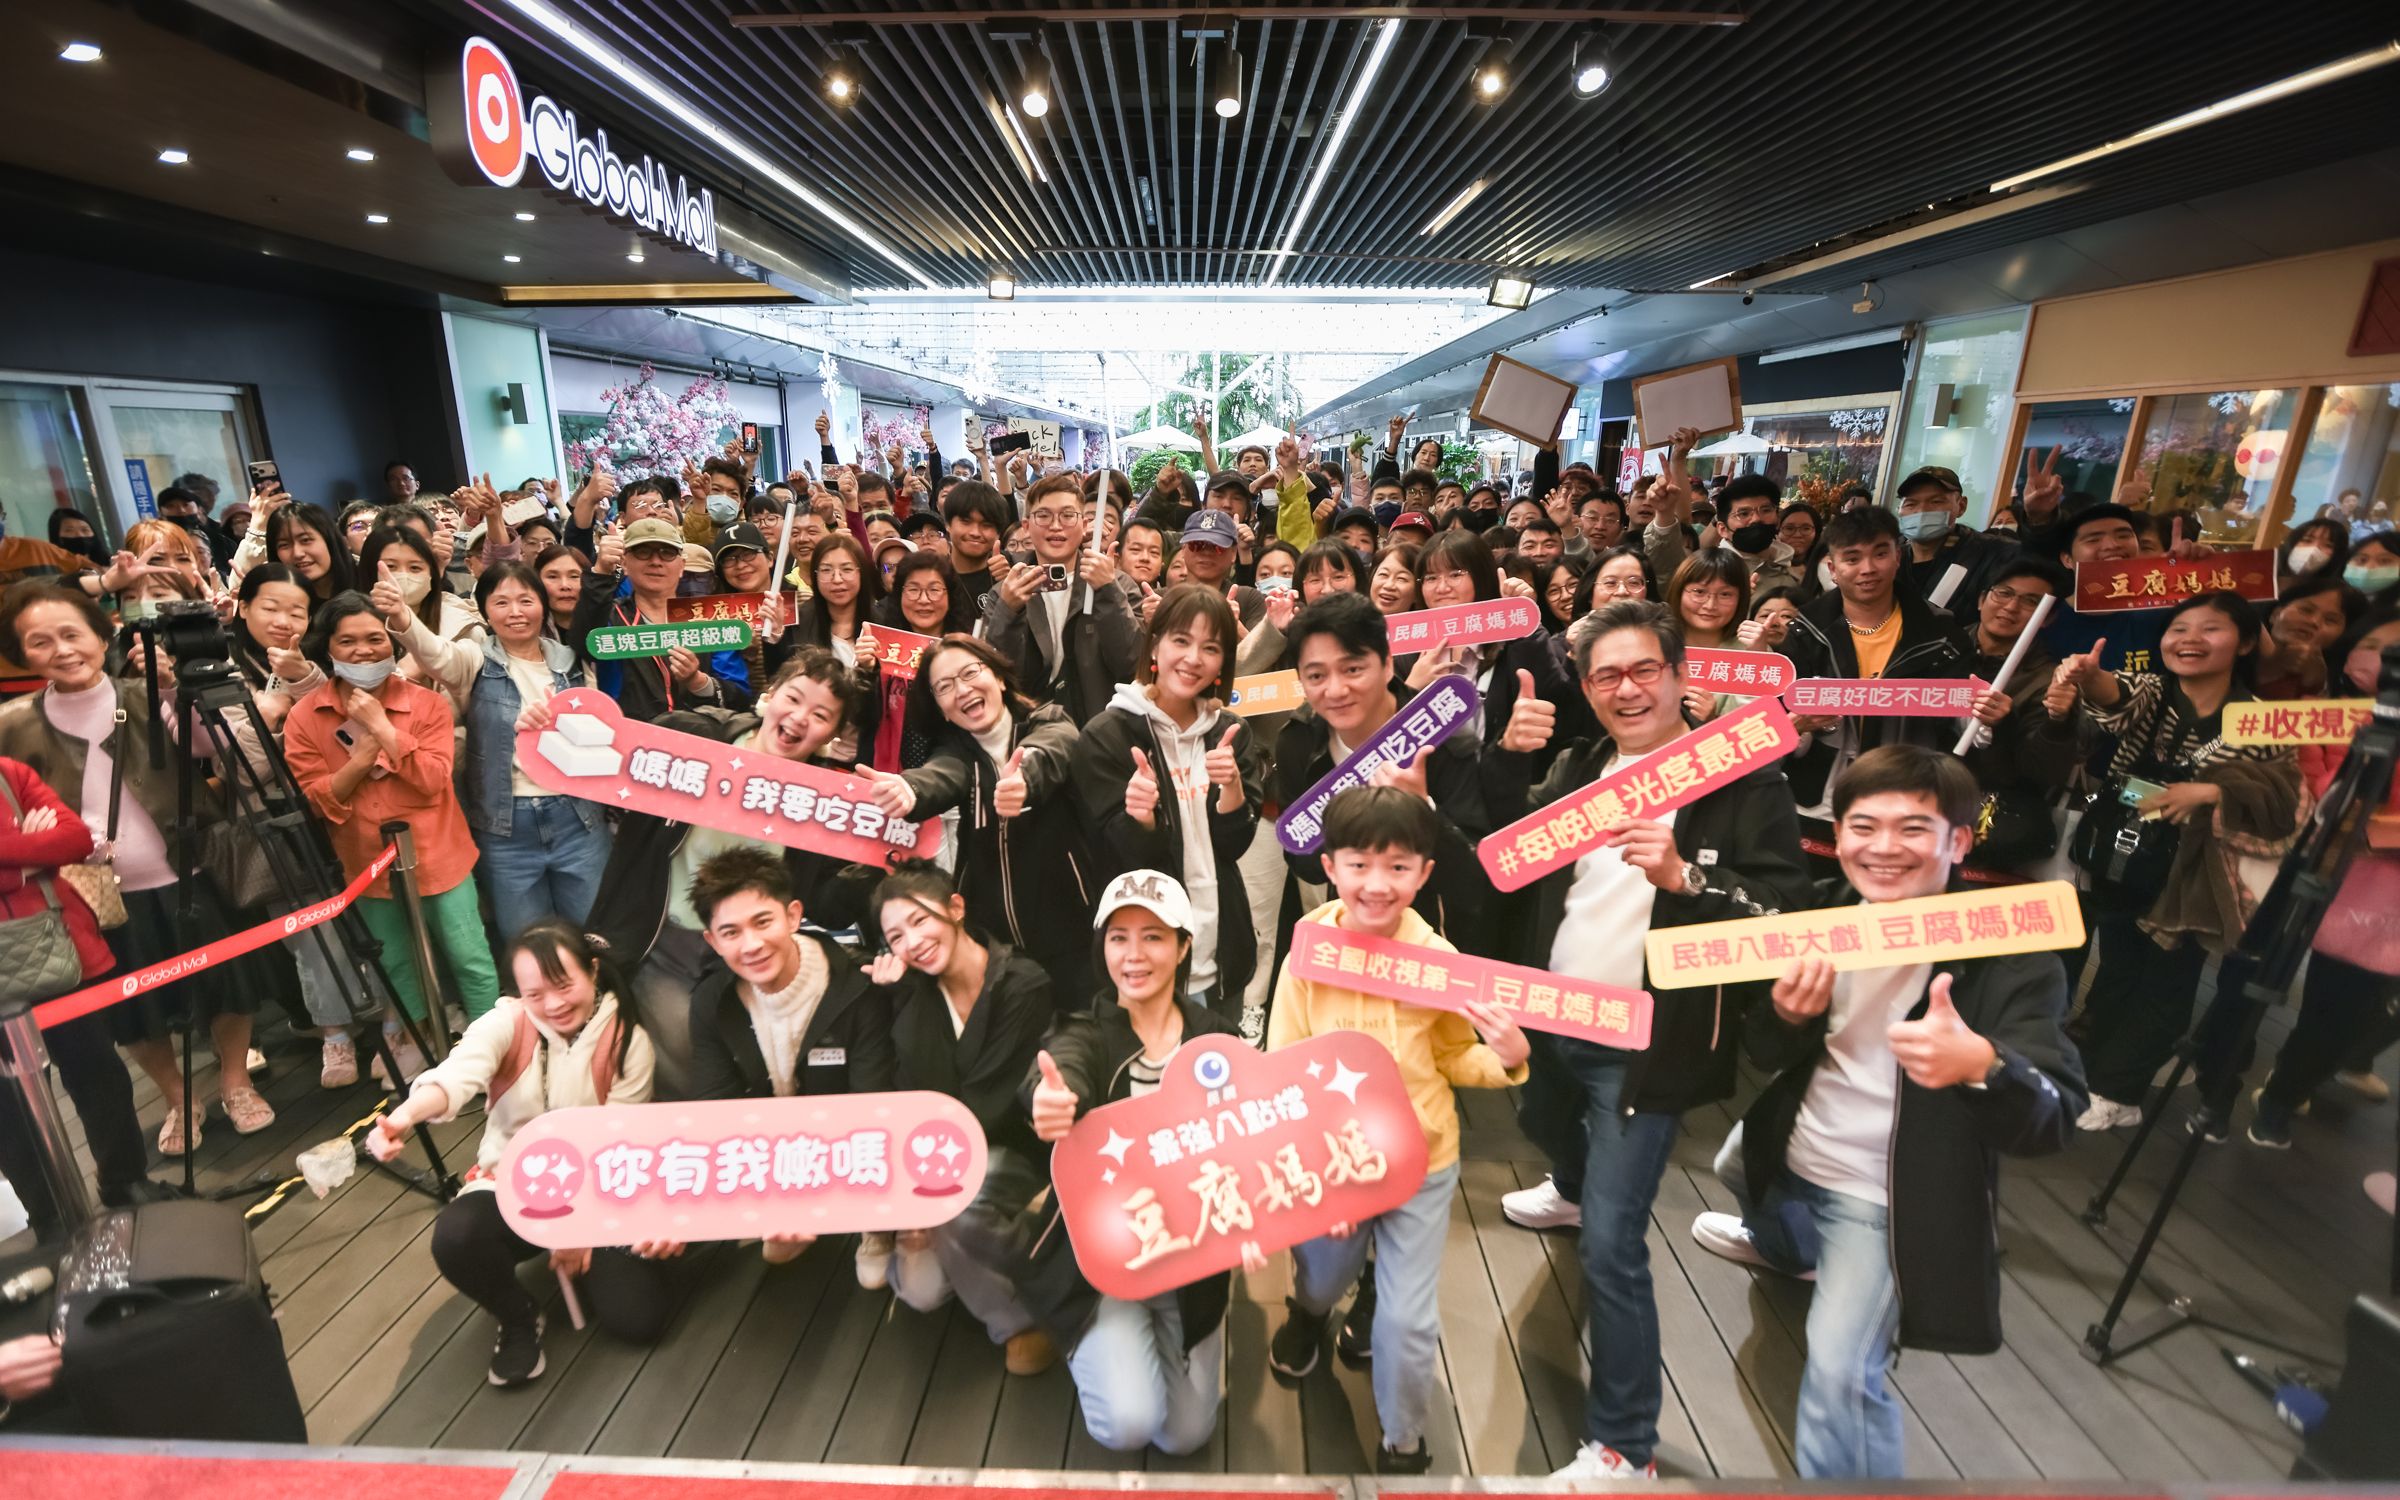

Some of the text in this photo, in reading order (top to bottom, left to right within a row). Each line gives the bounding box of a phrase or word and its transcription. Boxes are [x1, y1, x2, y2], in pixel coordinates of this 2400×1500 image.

[2105, 567, 2237, 599] 豆腐媽媽
[688, 600, 763, 622] 豆腐媽
[1442, 608, 1529, 637] 豆腐媽媽
[595, 626, 742, 653] 這塊豆腐超級嫩
[1687, 660, 1782, 686] 豆腐媽媽
[1793, 686, 1974, 708] 豆腐好吃不吃嗎
[1497, 711, 1781, 876] #每晚曝光度最高
[298, 904, 331, 925] Global
[1671, 900, 2056, 971] 民視八點大戲 豆腐媽媽
[140, 952, 207, 986] Global Mall
[1311, 941, 1632, 1033] 全國收視第一 豆腐媽媽
[1148, 1084, 1308, 1167] 最強八點檔
[594, 1131, 889, 1198] 你有我嫩嗎
[1121, 1118, 1387, 1270] 豆腐媽媽
